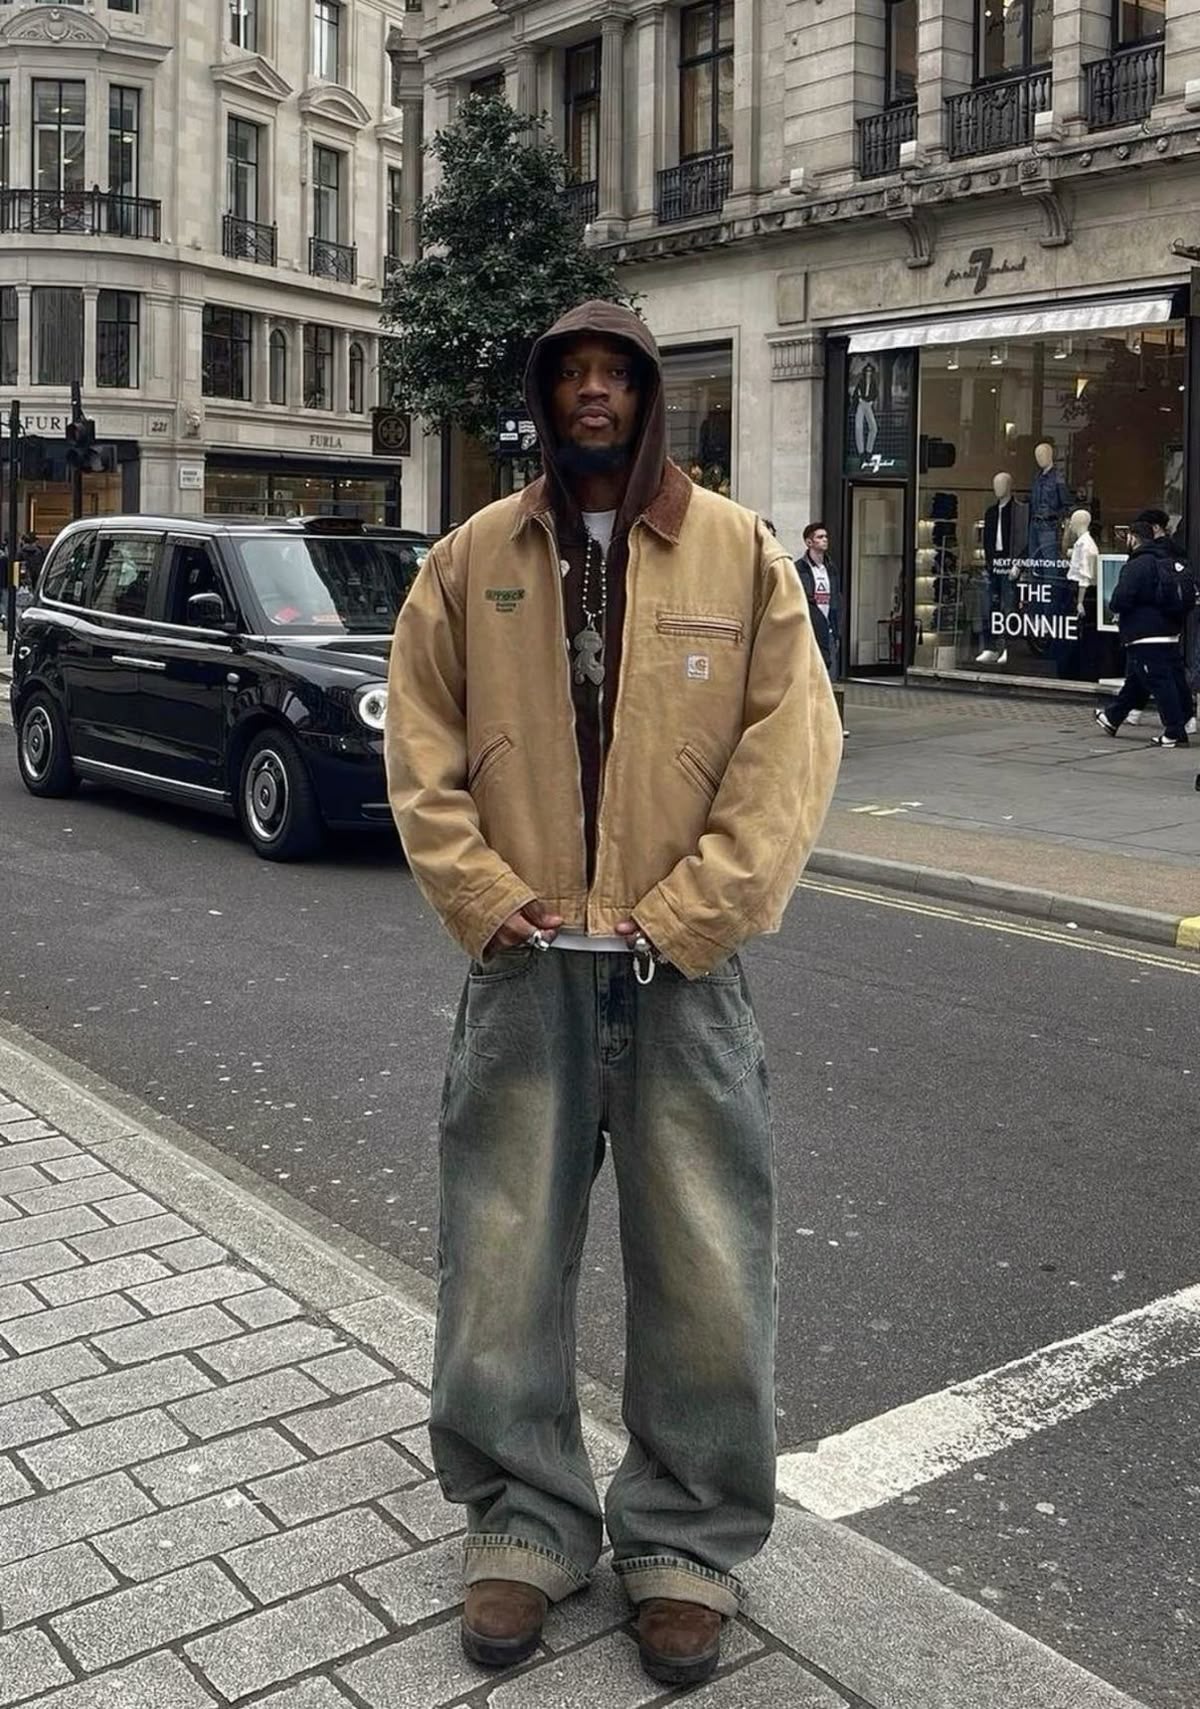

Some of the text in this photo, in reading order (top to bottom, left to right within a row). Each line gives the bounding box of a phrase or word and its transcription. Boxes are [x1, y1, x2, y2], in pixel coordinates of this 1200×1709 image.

[969, 248, 993, 294] 7
[25, 416, 69, 430] FUR
[310, 435, 342, 448] FURLA
[993, 559, 1011, 567] NEXT
[1012, 559, 1056, 567] GENERATION
[1017, 584, 1051, 602] THE
[992, 612, 1078, 639] BONNIE
